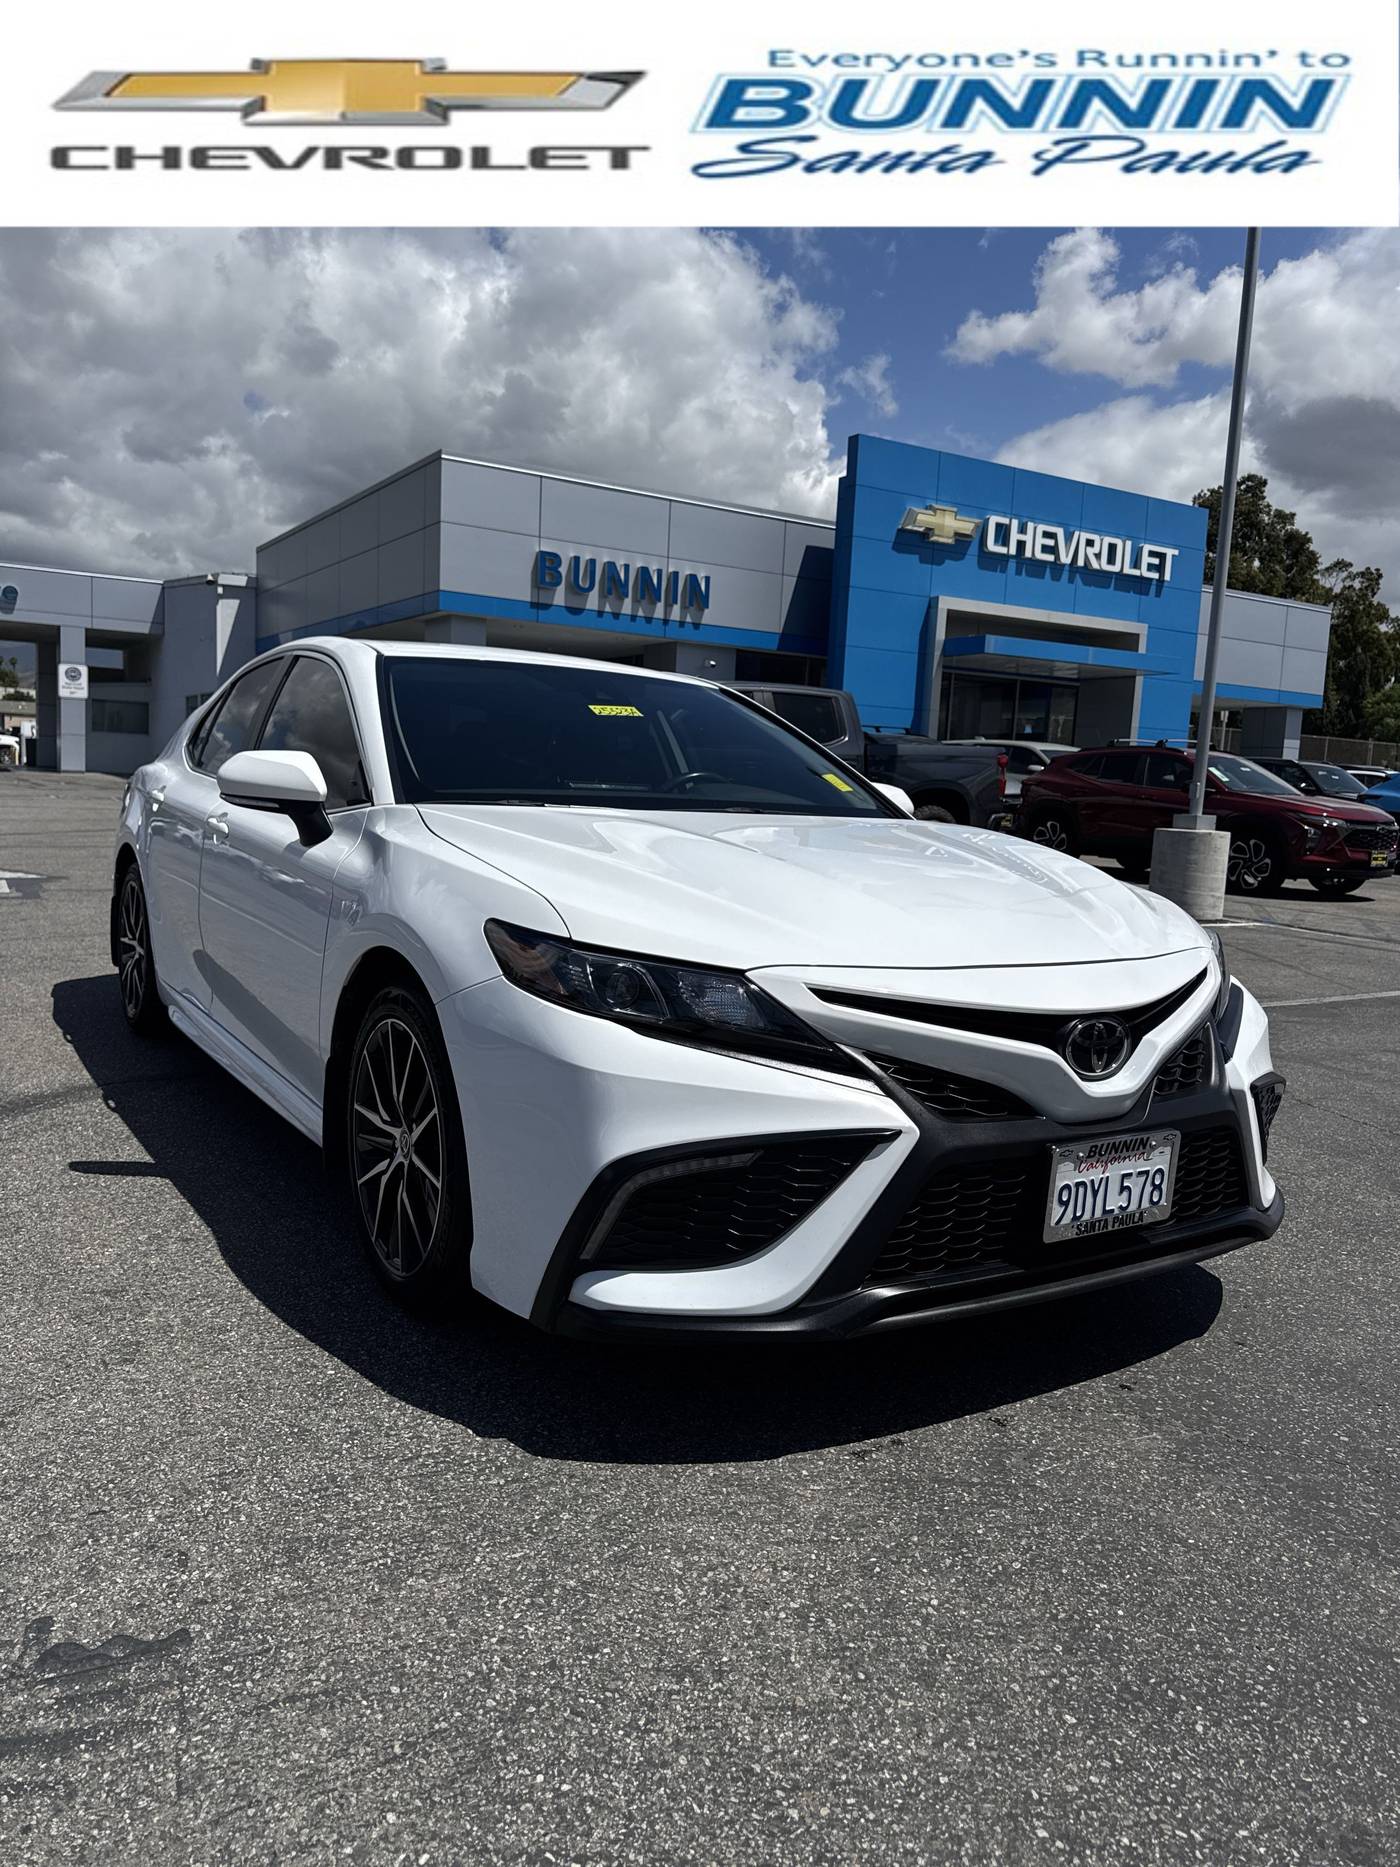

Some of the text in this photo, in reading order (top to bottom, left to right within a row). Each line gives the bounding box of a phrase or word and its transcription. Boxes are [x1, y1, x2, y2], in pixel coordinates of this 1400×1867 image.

[984, 514, 1180, 582] CHEVROLET
[534, 549, 711, 609] BUNNIN
[1077, 1151, 1153, 1174] California
[1086, 1136, 1150, 1159] BUNNIN
[1055, 1166, 1165, 1226] 9DYL578
[1076, 1210, 1144, 1235] SANTA PAULA
